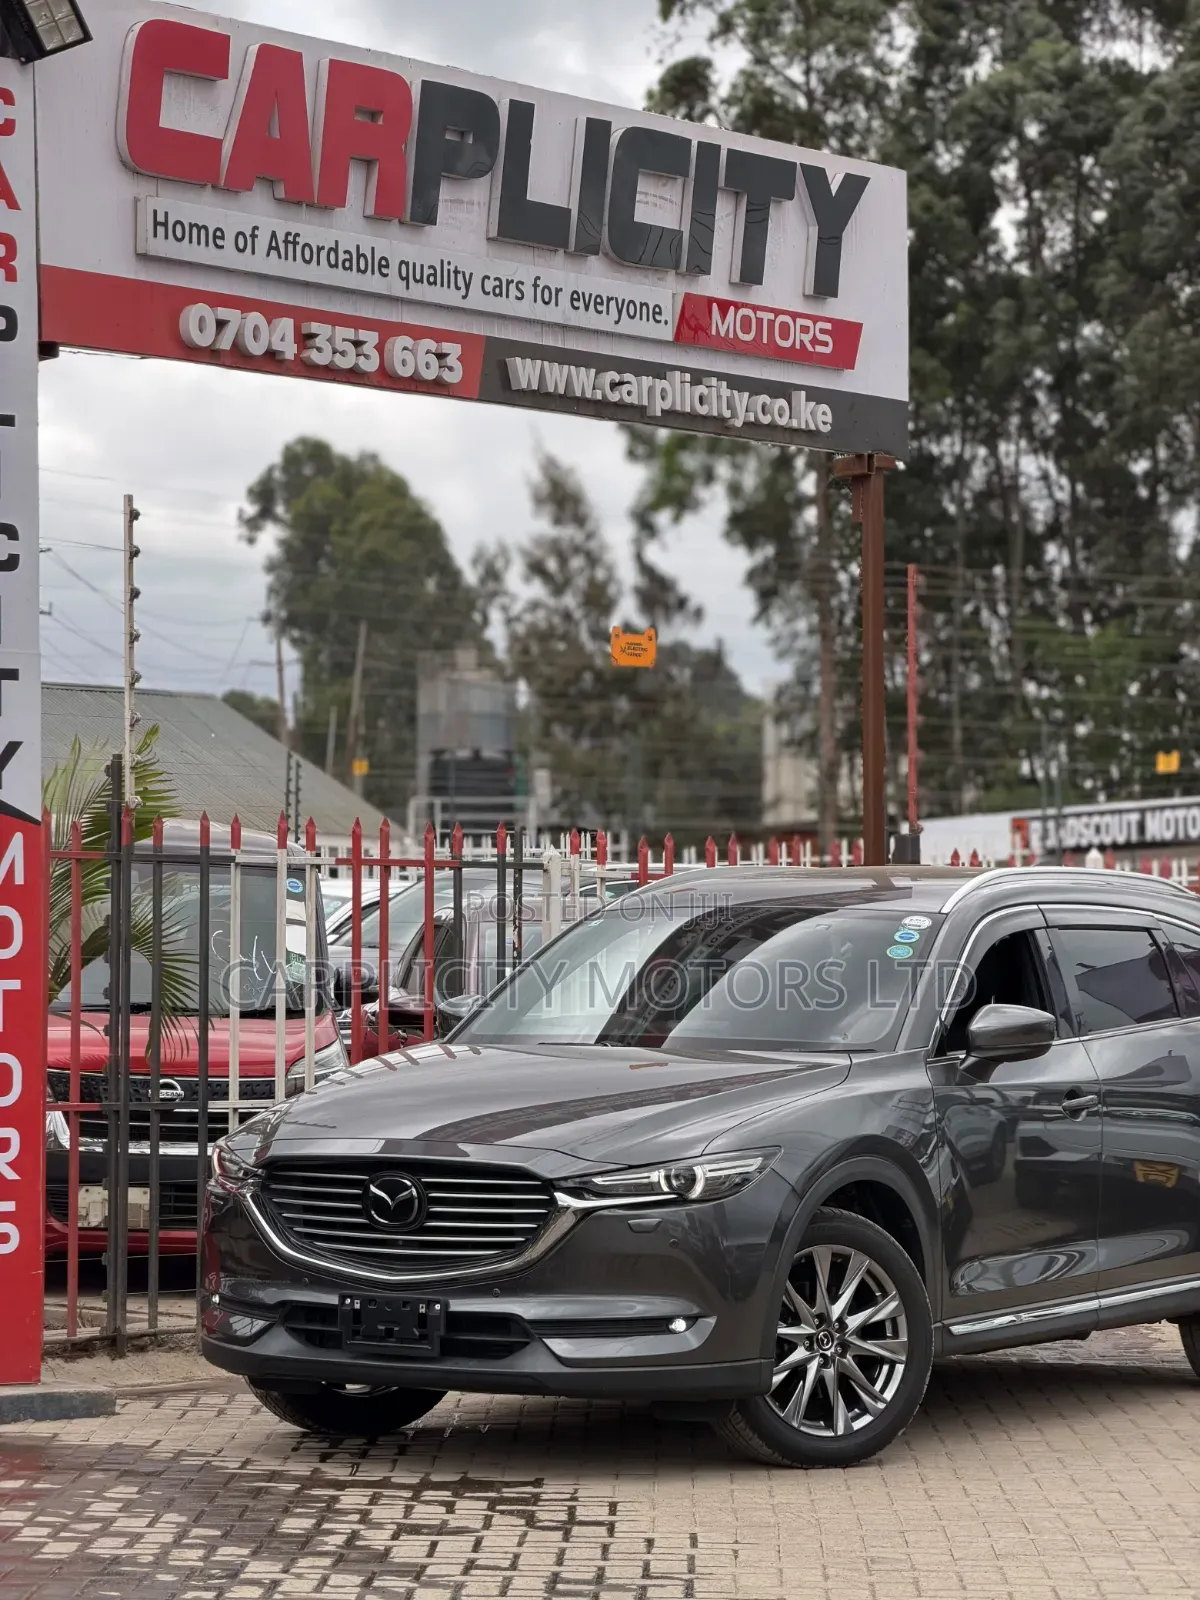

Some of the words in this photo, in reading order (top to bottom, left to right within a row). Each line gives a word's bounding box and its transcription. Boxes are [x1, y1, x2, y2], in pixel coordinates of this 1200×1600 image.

[117, 18, 870, 299] CARPLICITY
[152, 208, 226, 250] Home
[234, 225, 260, 256] of
[265, 229, 391, 278] Affordable
[398, 258, 474, 300] quality
[480, 273, 525, 300] cars
[532, 275, 563, 307] for
[570, 289, 669, 326] everyone.
[179, 302, 297, 360] 0704
[300, 321, 380, 374] 353
[384, 335, 463, 384] 663
[711, 302, 834, 355] MOTORS
[505, 356, 833, 433] www.carplicity.co.ke
